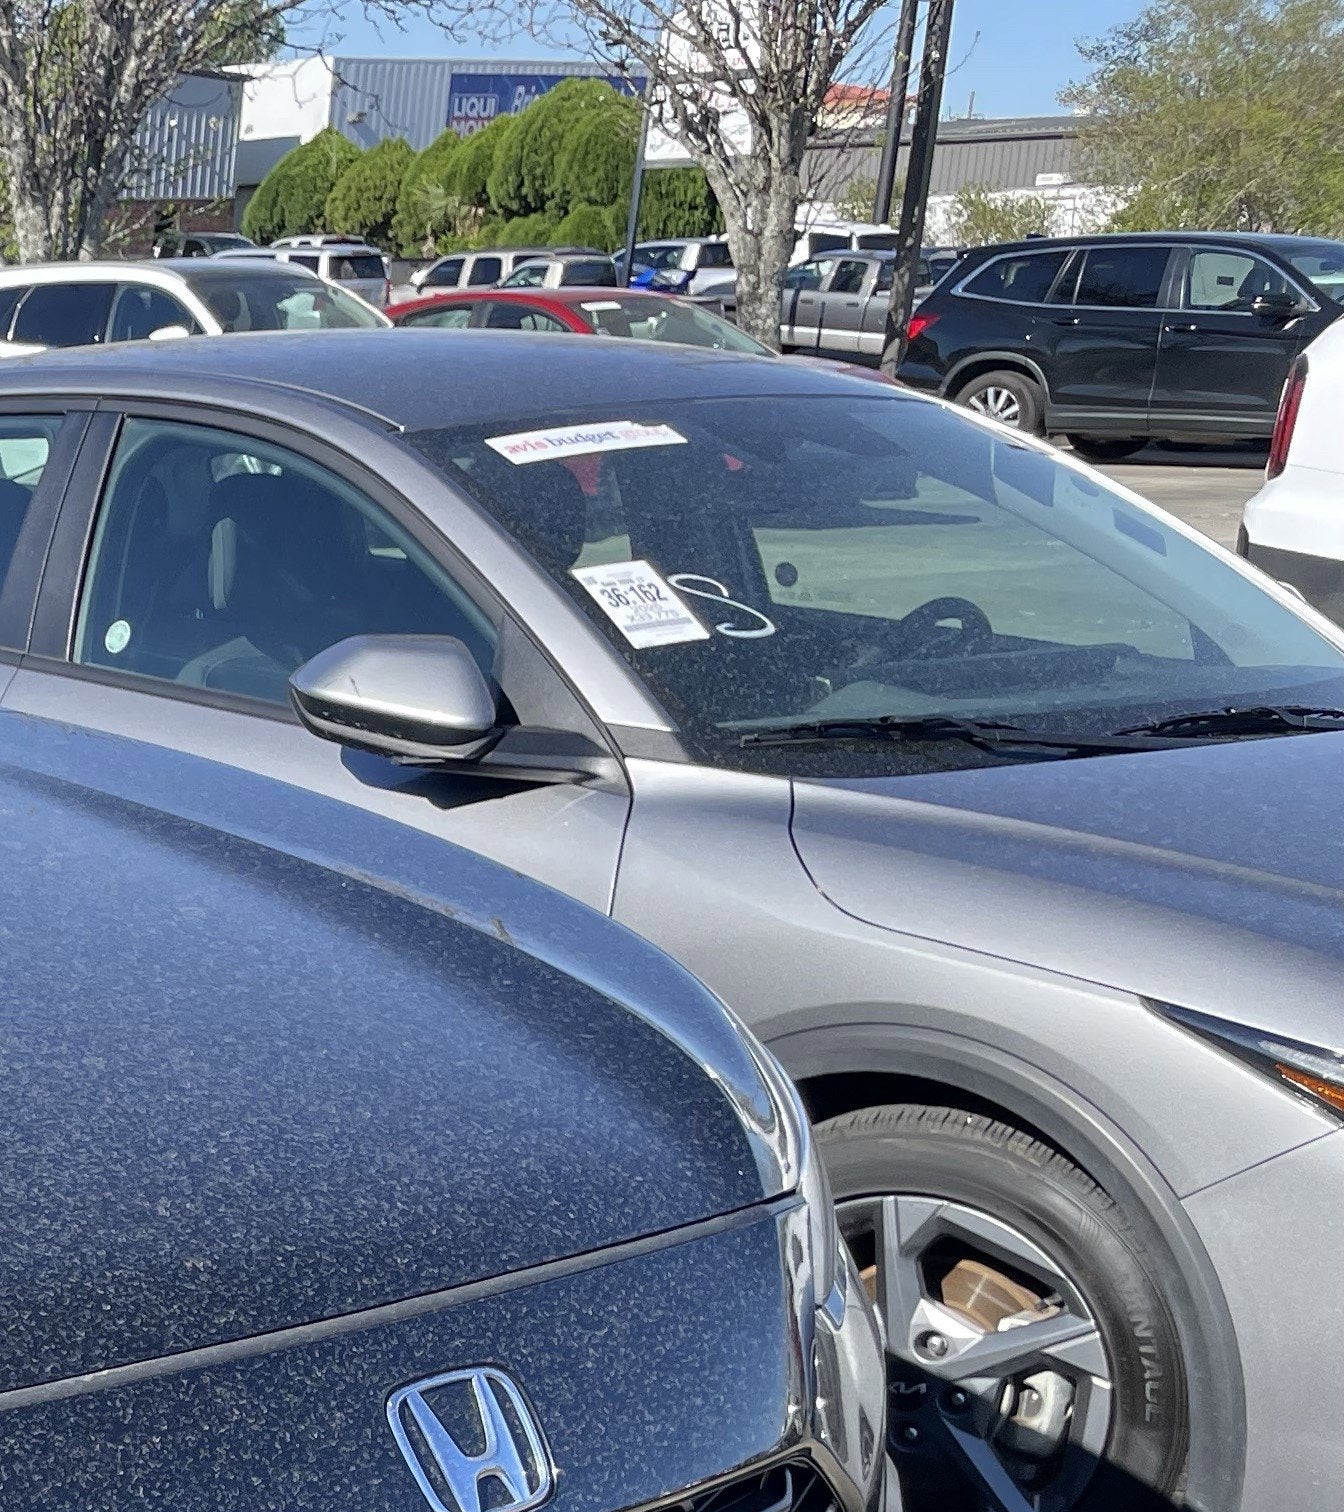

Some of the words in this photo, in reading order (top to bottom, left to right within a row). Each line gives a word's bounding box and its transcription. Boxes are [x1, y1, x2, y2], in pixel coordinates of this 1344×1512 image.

[453, 96, 497, 118] LIQUI
[544, 431, 620, 447] budget
[600, 582, 668, 608] 36:162
